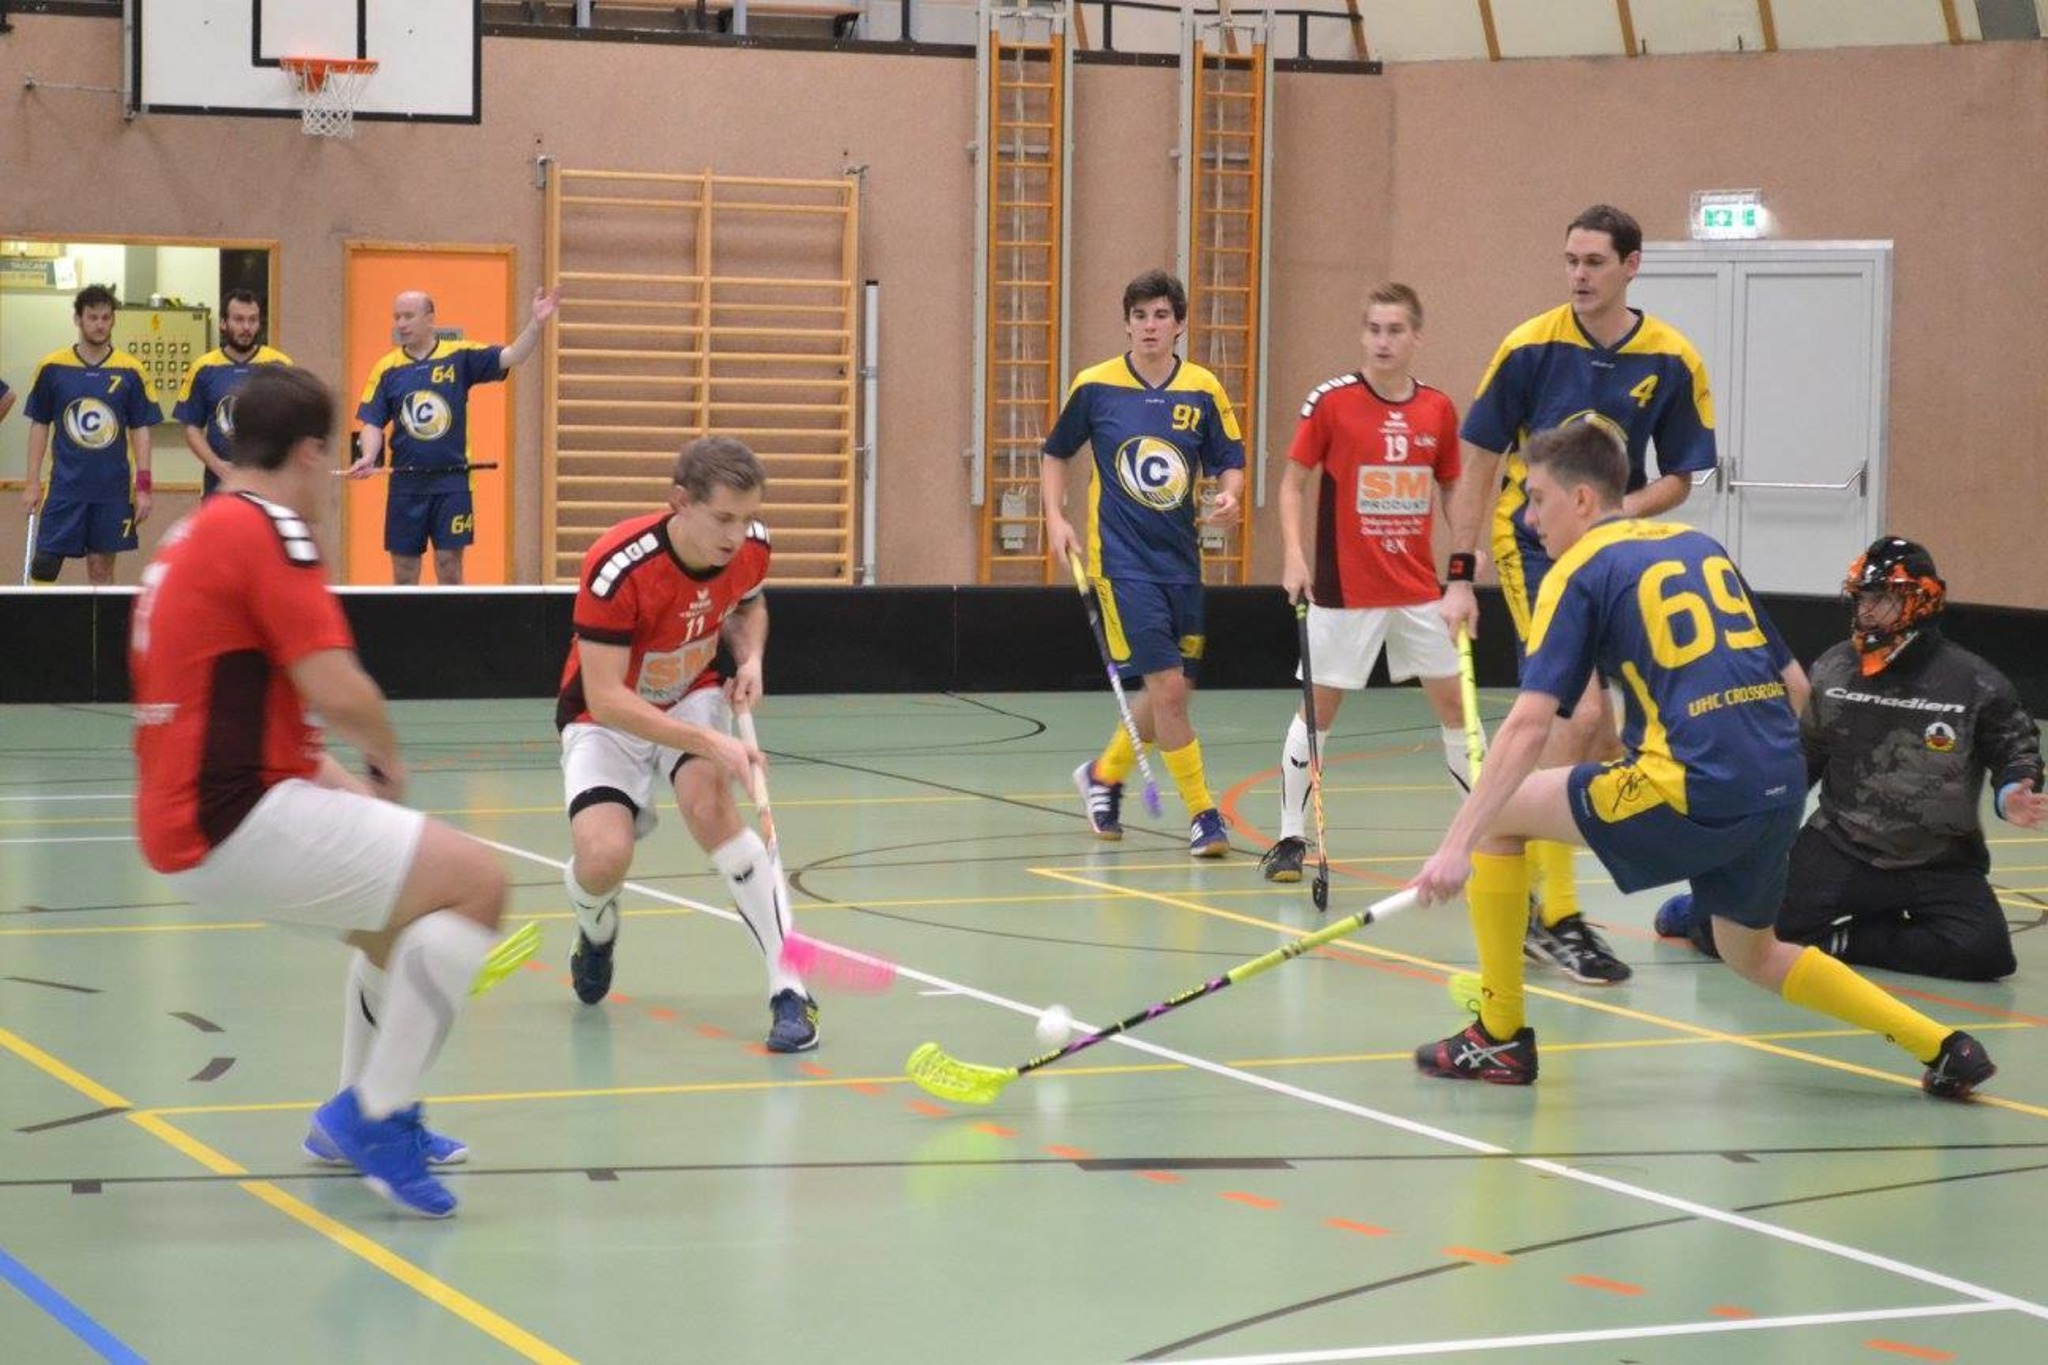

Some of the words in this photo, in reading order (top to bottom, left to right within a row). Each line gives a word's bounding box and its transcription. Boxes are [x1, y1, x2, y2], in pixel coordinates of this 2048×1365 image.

[107, 375, 123, 394] 7
[431, 364, 455, 383] 64
[1629, 374, 1659, 408] 4
[81, 411, 101, 432] C
[1172, 404, 1201, 431] 91
[1384, 435, 1409, 462] 19
[1140, 455, 1169, 487] C
[1363, 471, 1429, 499] SM
[121, 518, 133, 538] 7
[451, 513, 473, 534] 64
[1637, 555, 1768, 670] 69
[685, 615, 705, 642] 11
[1688, 693, 1722, 717] UHC
[1825, 687, 1966, 713] Canadien
